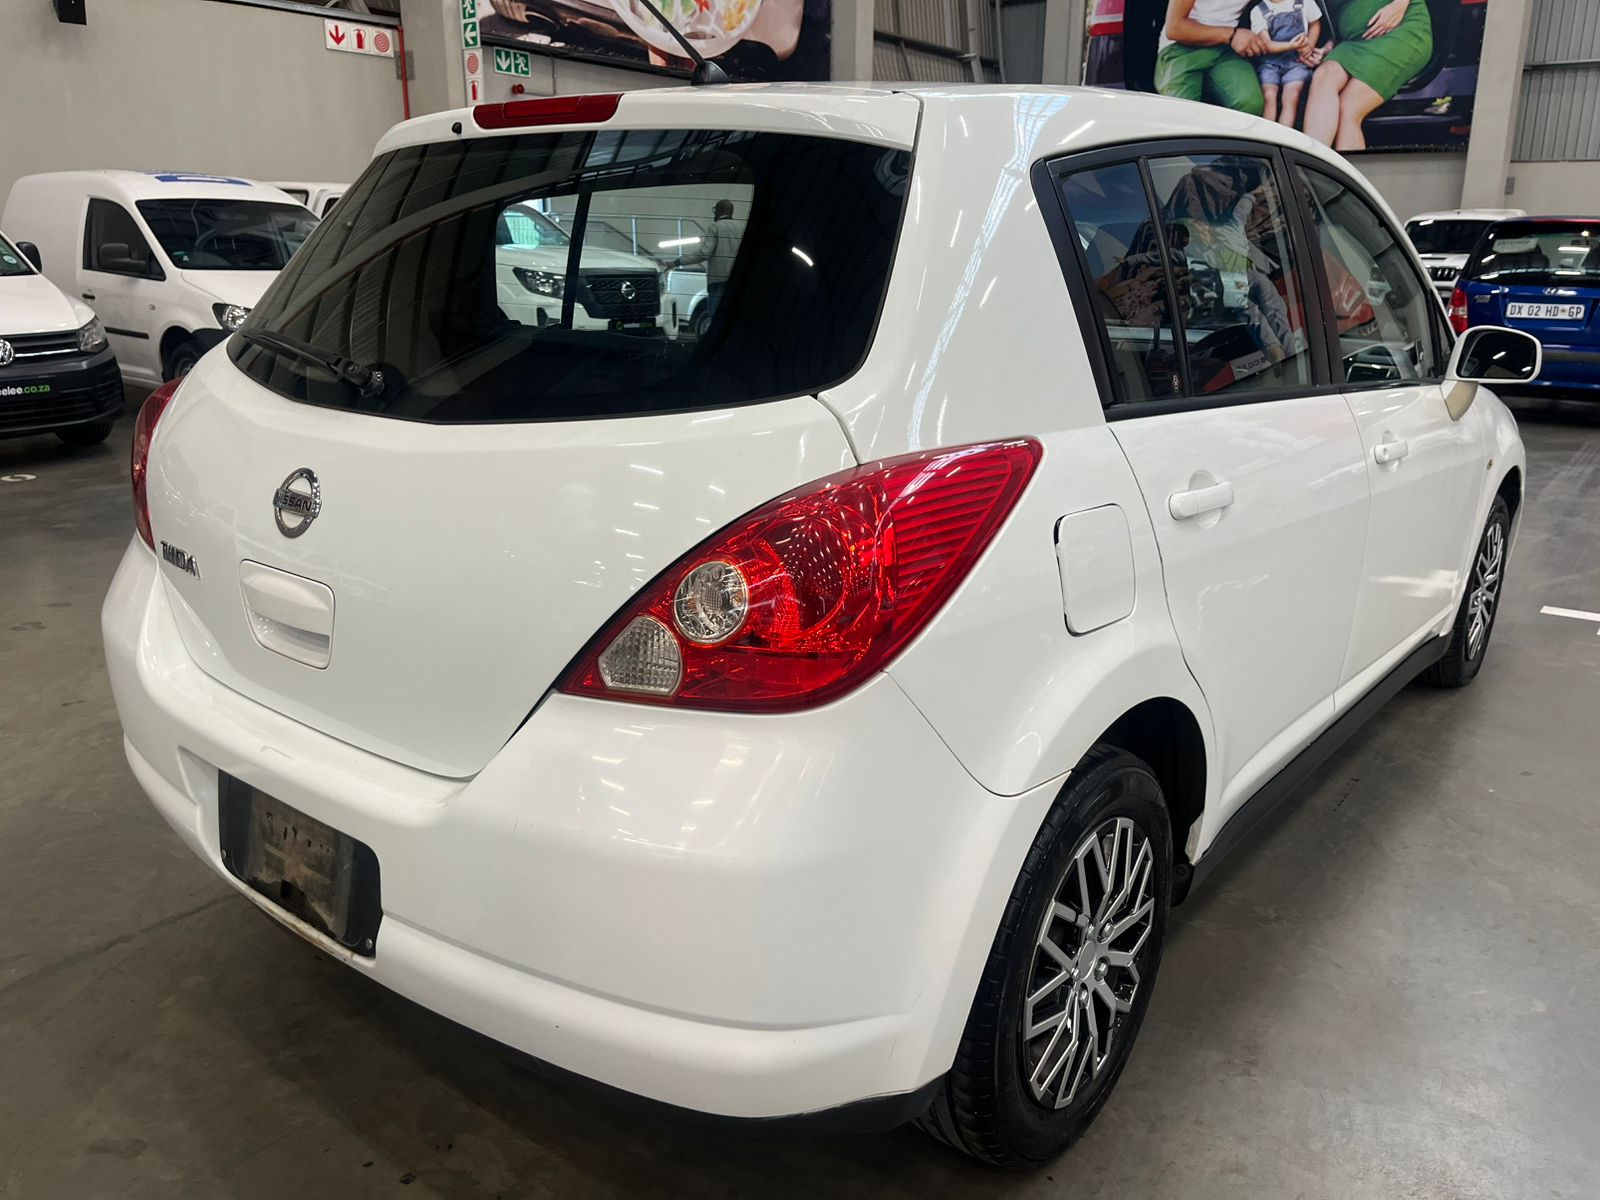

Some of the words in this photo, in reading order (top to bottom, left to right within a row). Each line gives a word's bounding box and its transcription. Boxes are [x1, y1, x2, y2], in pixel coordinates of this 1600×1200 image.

[1509, 304, 1523, 316] DX
[1527, 305, 1541, 317] 02
[1545, 305, 1559, 317] HD
[1568, 306, 1582, 318] GP
